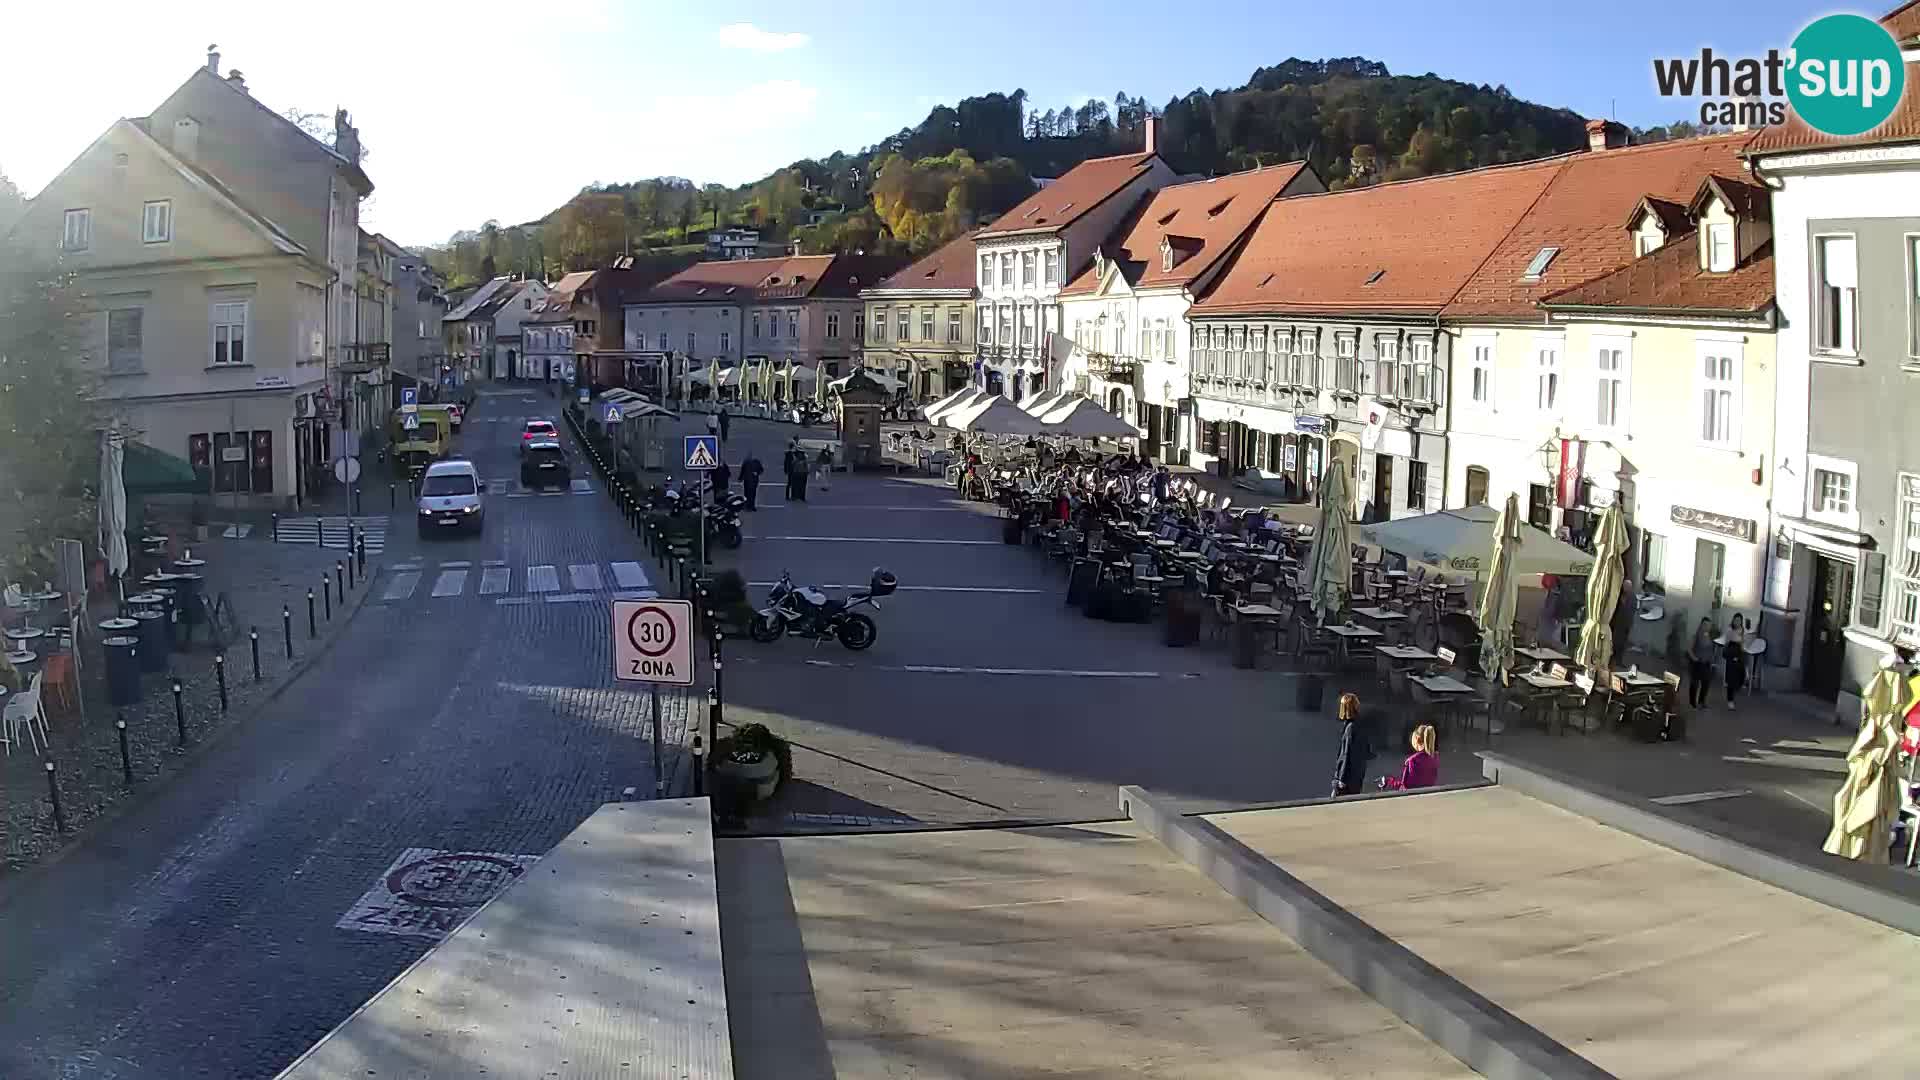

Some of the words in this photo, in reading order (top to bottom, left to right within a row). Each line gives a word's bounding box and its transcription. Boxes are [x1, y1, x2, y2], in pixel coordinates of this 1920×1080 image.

[405, 391, 413, 402] P
[640, 622, 665, 643] 30
[631, 659, 676, 677] ZONA
